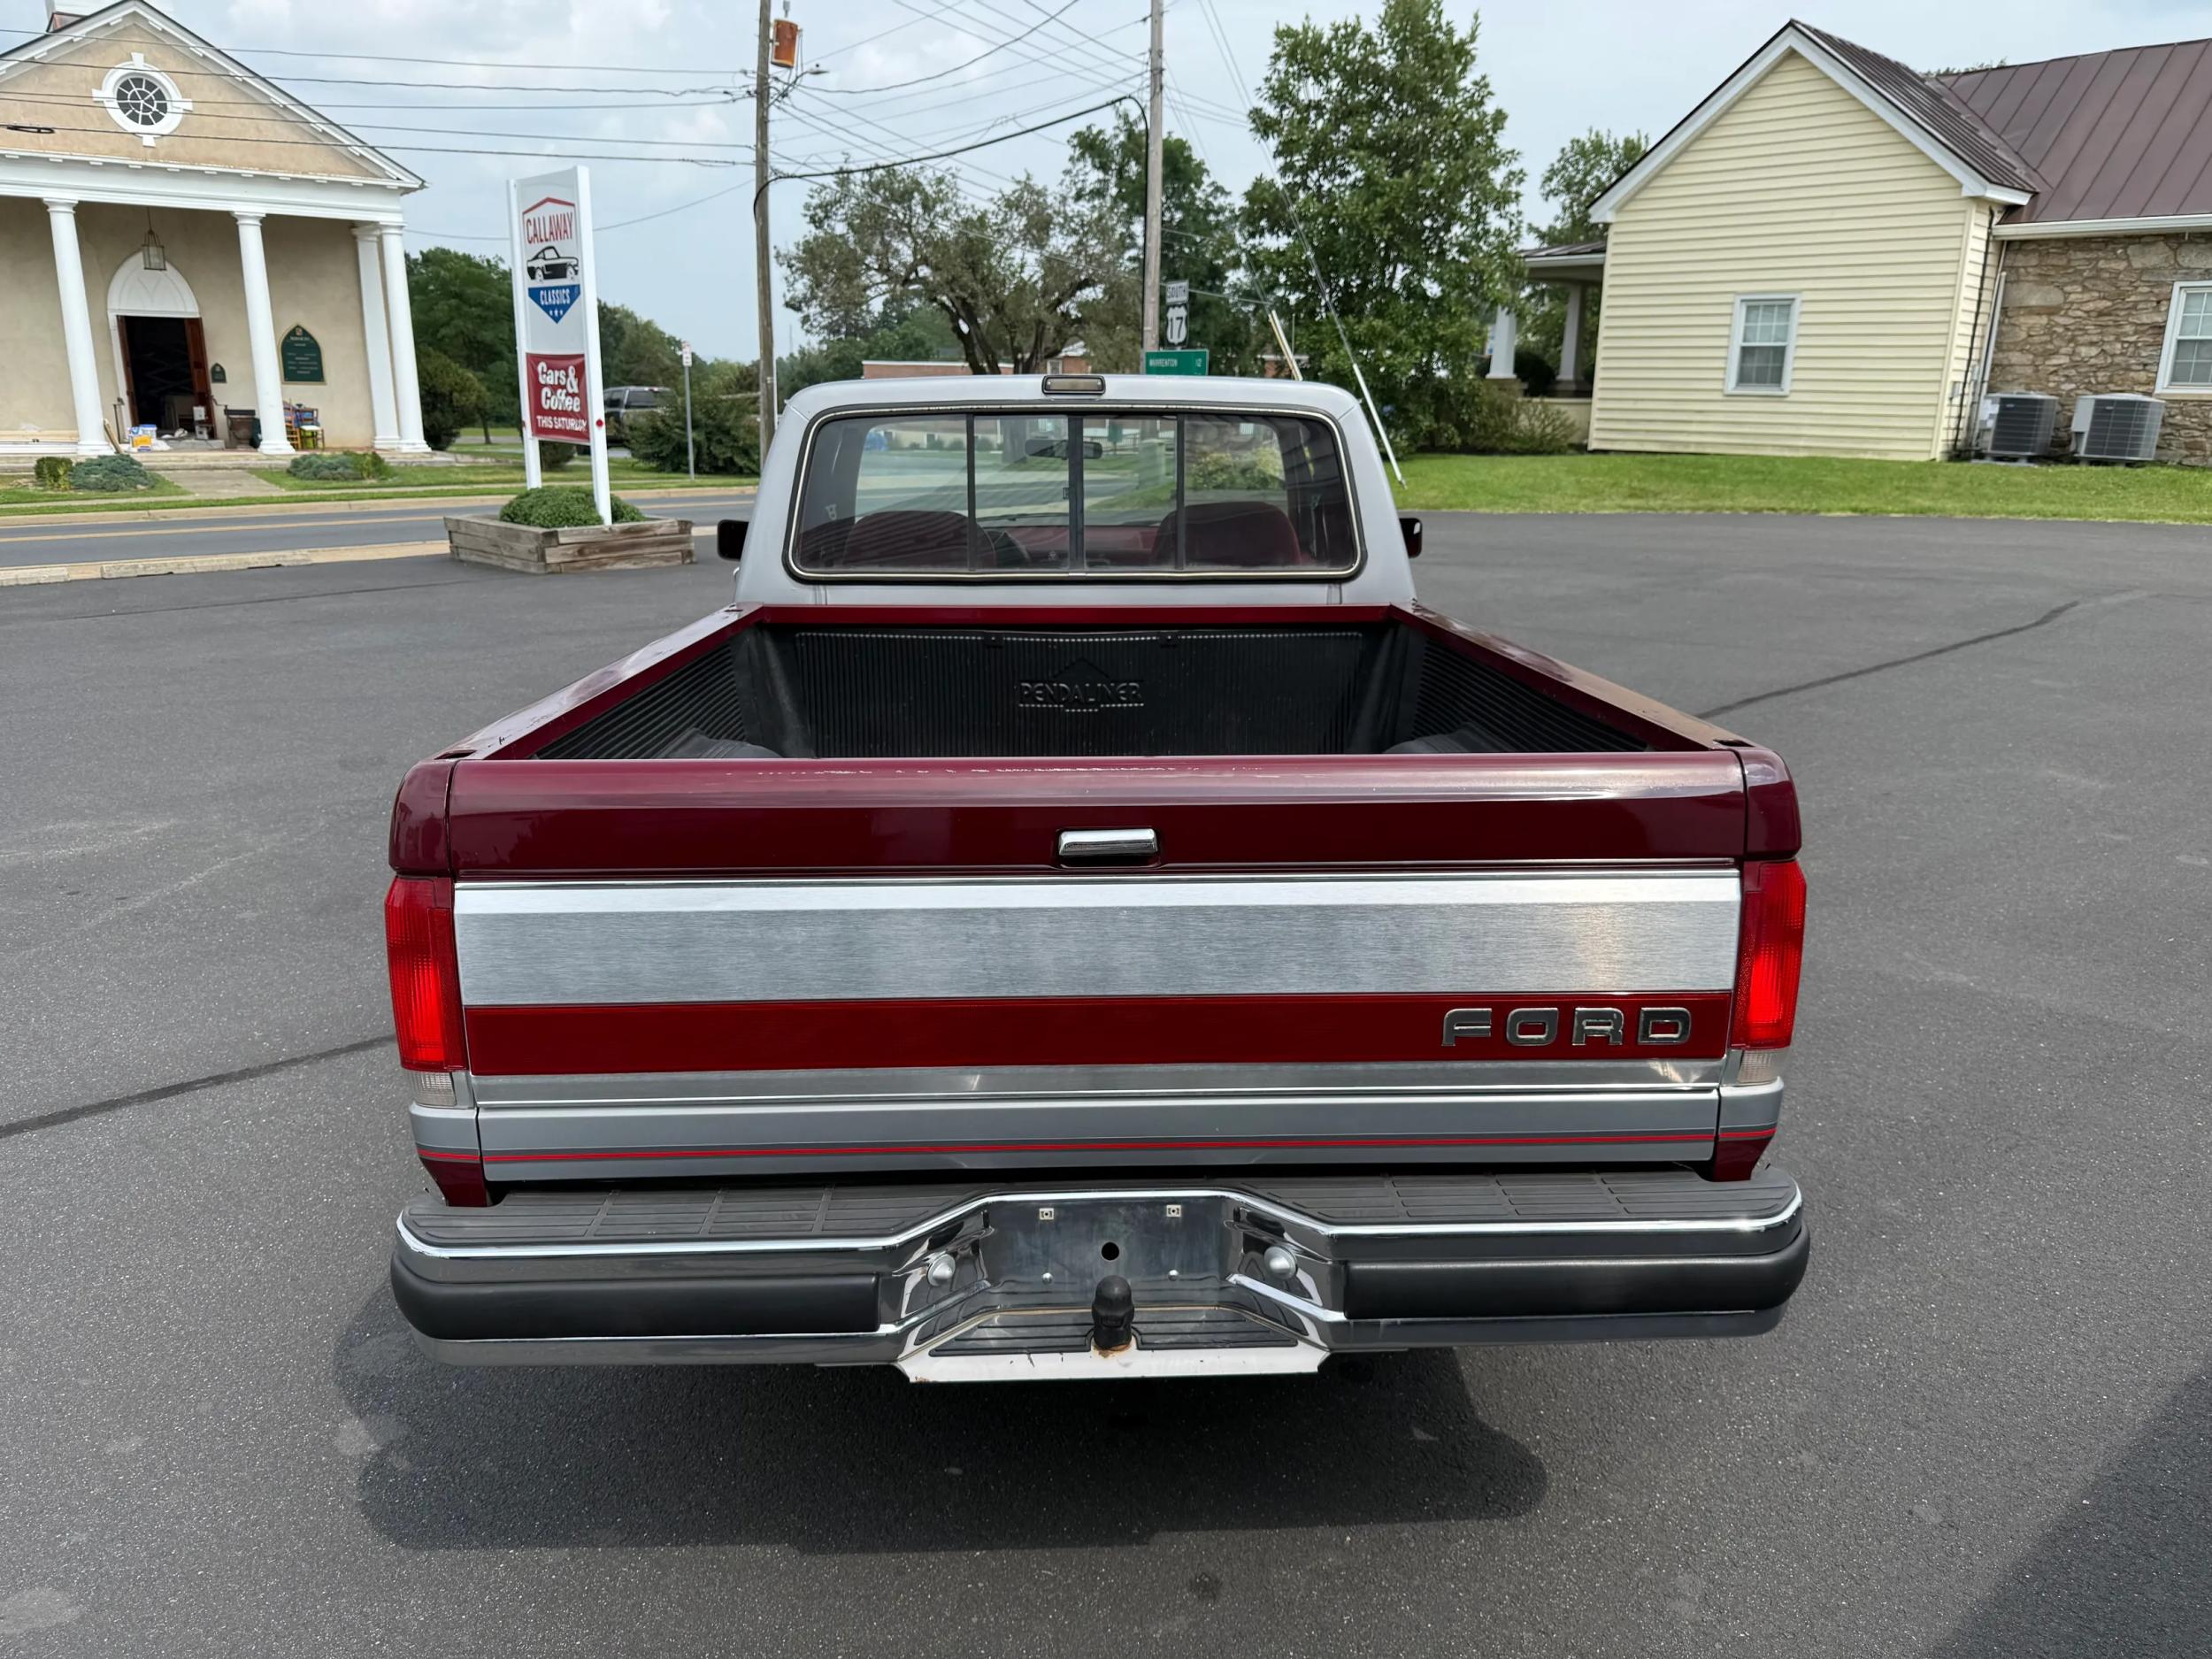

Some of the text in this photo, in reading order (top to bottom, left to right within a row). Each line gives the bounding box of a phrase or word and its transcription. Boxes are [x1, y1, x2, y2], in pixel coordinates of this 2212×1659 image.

[526, 212, 573, 244] CALLAWAY
[540, 288, 571, 305] CLASSICS
[1167, 284, 1187, 298] SOUTH
[1170, 317, 1184, 339] 17
[537, 361, 579, 394] Cars &
[541, 387, 580, 412] Coffee
[536, 414, 554, 429] THIS
[1019, 682, 1143, 703] PENDALINER
[1441, 1007, 1692, 1047] FORD
